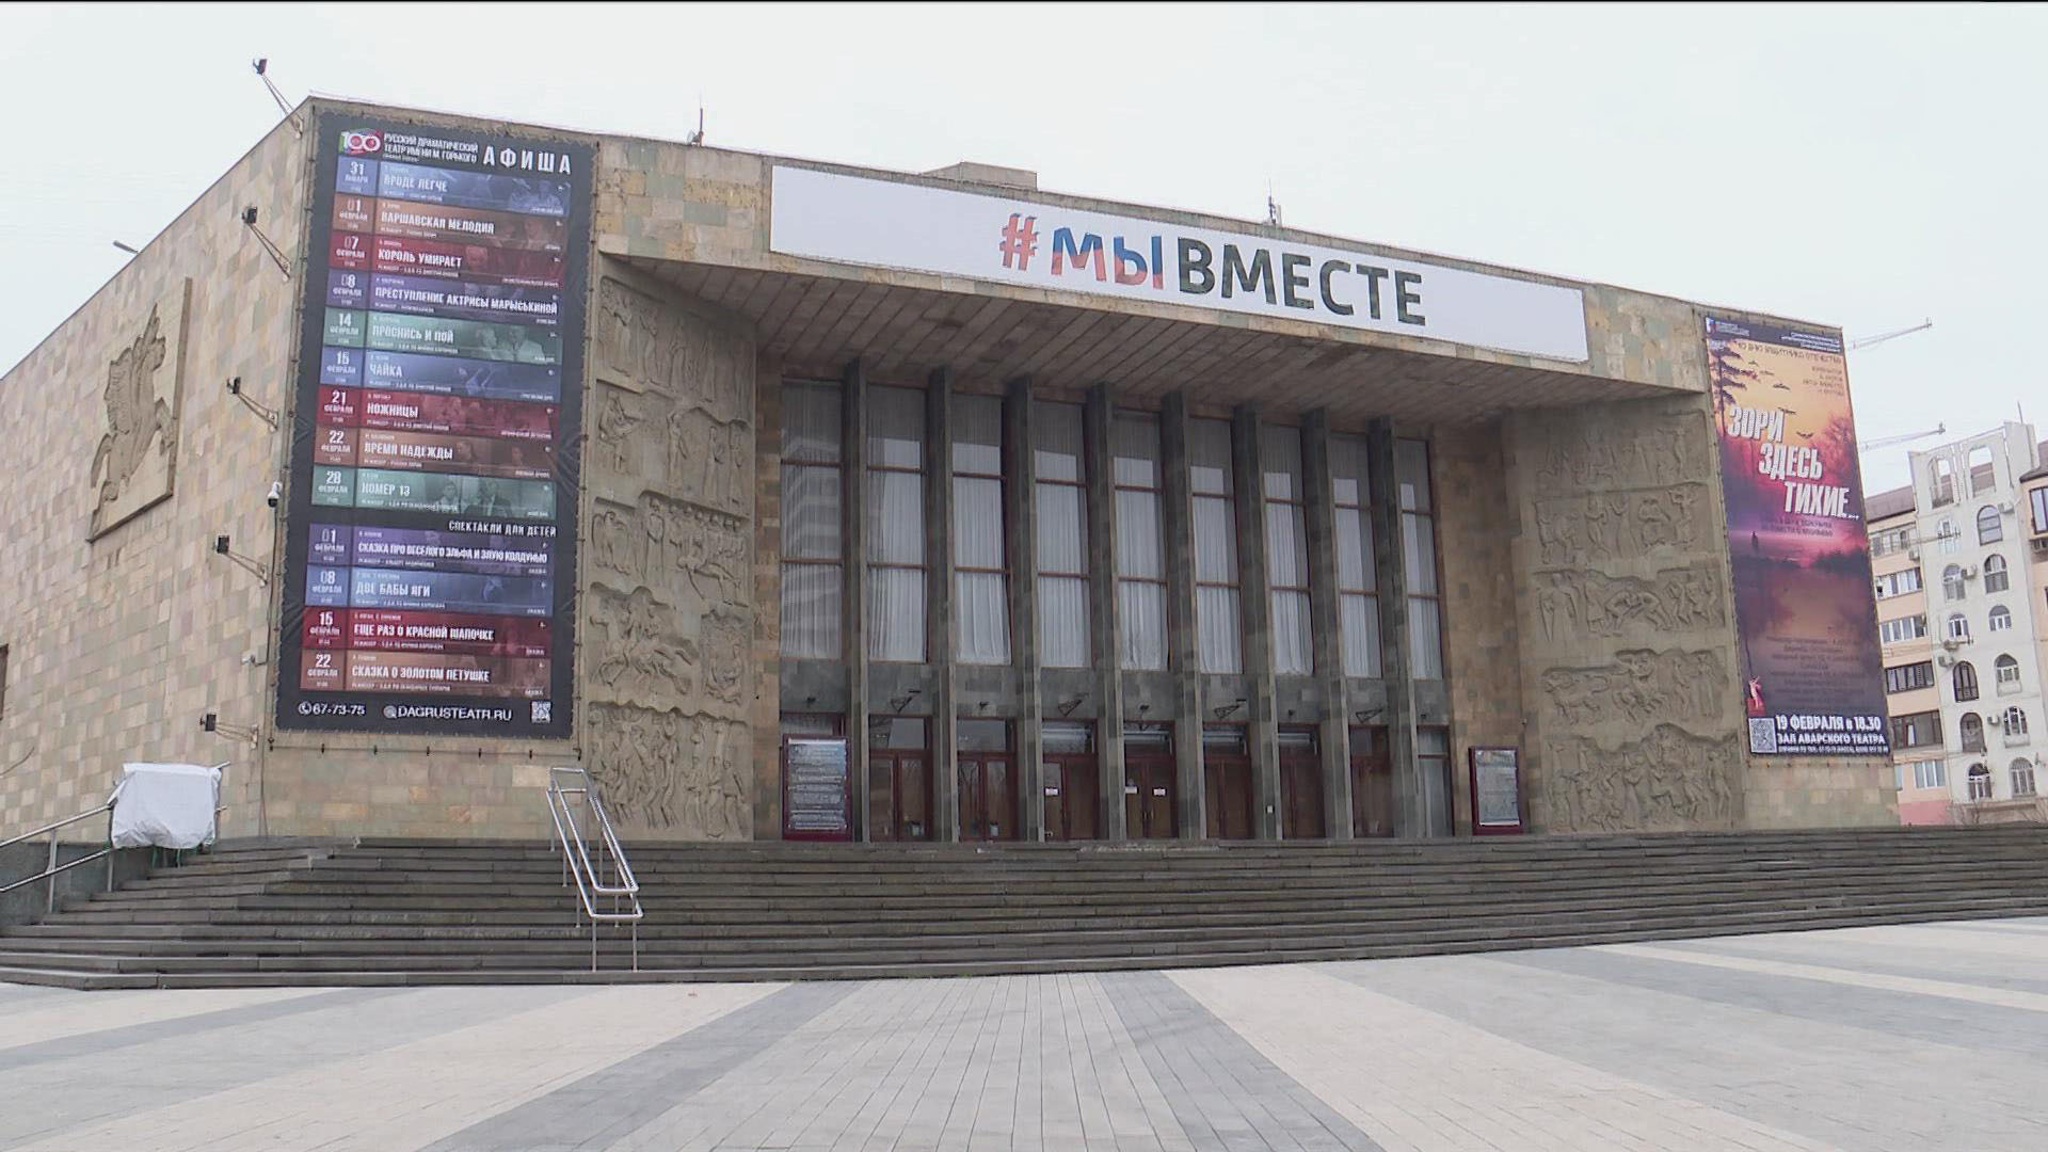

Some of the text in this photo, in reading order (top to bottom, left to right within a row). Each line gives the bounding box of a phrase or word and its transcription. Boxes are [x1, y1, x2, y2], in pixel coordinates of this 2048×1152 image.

[383, 133, 479, 153] РУССКИЙ ДРАМАТИЧЕСКИЙ
[384, 143, 406, 153] ТЕАТР
[441, 149, 478, 164] ГОРЬКОГО
[483, 145, 572, 175] АФИША
[349, 161, 366, 175] 31
[383, 174, 448, 193] ВРОДЕ ЛЕГЧЕ
[346, 198, 361, 212] 01
[339, 211, 368, 223] ФЕВРАЛЯ
[381, 211, 446, 230] ВАРШАВСКАЯ
[447, 220, 495, 235] МЕЛОДИЯ
[343, 235, 360, 250] 07
[335, 248, 366, 260] ФЕВРАЛЯ
[377, 248, 463, 269] КОРОЛЬ УМИРАЕТ
[999, 212, 1427, 327] #МЫВМЕСТЕ
[340, 274, 357, 289] 08
[332, 287, 363, 298] ФЕВРАЛЯ
[374, 287, 445, 304] ПРЕСТУПЛЕНИЕ
[446, 295, 490, 309] АКТРИСЫ
[490, 298, 558, 315] МАРЫСЬКИНОЙ
[338, 312, 352, 327] 14
[329, 325, 360, 336] ФЕВРАЛЯ
[371, 324, 454, 343] ПРОСНИСЬ И ПОЙ
[336, 350, 351, 365] 15
[326, 364, 357, 375] ФЕВРАЛЯ
[369, 363, 403, 378] ЧАЙКА
[331, 390, 347, 405] 21
[323, 403, 354, 415] ФЕВРАЛЯ
[366, 402, 419, 419] НОЖНИЦЫ
[1727, 406, 1785, 443] ЗОРИ
[328, 429, 345, 445] 22
[320, 444, 352, 454] ФЕВРАЛЯ
[364, 441, 453, 460] ВРЕМЯ НАДЕЖДЫ
[1758, 442, 1824, 481] ЗДЕСЬ
[325, 470, 342, 485] 28
[318, 484, 349, 495] ФЕВРАЛЯ
[361, 482, 411, 498] НОМЕР 13
[321, 528, 337, 544] 01
[448, 520, 558, 538] СПЕКТАКЛИ ДЛЯ ДЕТЕЙ
[313, 543, 346, 553] ФЕВРАЛЯ
[358, 542, 389, 555] СКАЗКА
[390, 543, 405, 556] ПРО
[406, 544, 446, 558] ВЕСЕЛОГО
[446, 547, 473, 561] ЭЛЬФА
[480, 550, 505, 563] ЗЛУЮ
[505, 552, 548, 565] КОЛДУНЬЮ
[320, 570, 336, 585] 08
[311, 584, 343, 595] ФЕВРАЛЯ
[355, 582, 431, 598] ДВЕ БАБЫ ЯГИ
[318, 611, 334, 626] 15
[309, 625, 341, 637] ФЕВРАЛЯ
[353, 623, 495, 642] ЕЩЕ РАЗ О КРАСНОЙ ШАПОЧКЕ
[315, 653, 332, 669] 22
[307, 668, 339, 679] ФЕВРАЛЯ
[351, 665, 491, 684] СКАЗКА О ЗОЛОТОМ ПЕТУШКЕ
[397, 706, 513, 722] DAGRUSTEATR.RU
[1775, 714, 1788, 730] 19
[1789, 714, 1845, 731] ФЕВРАЛЯ
[1853, 716, 1882, 731] 18.30
[1777, 732, 1886, 745] ЗАЛ АВАРСКОГО ТЕАТРА
